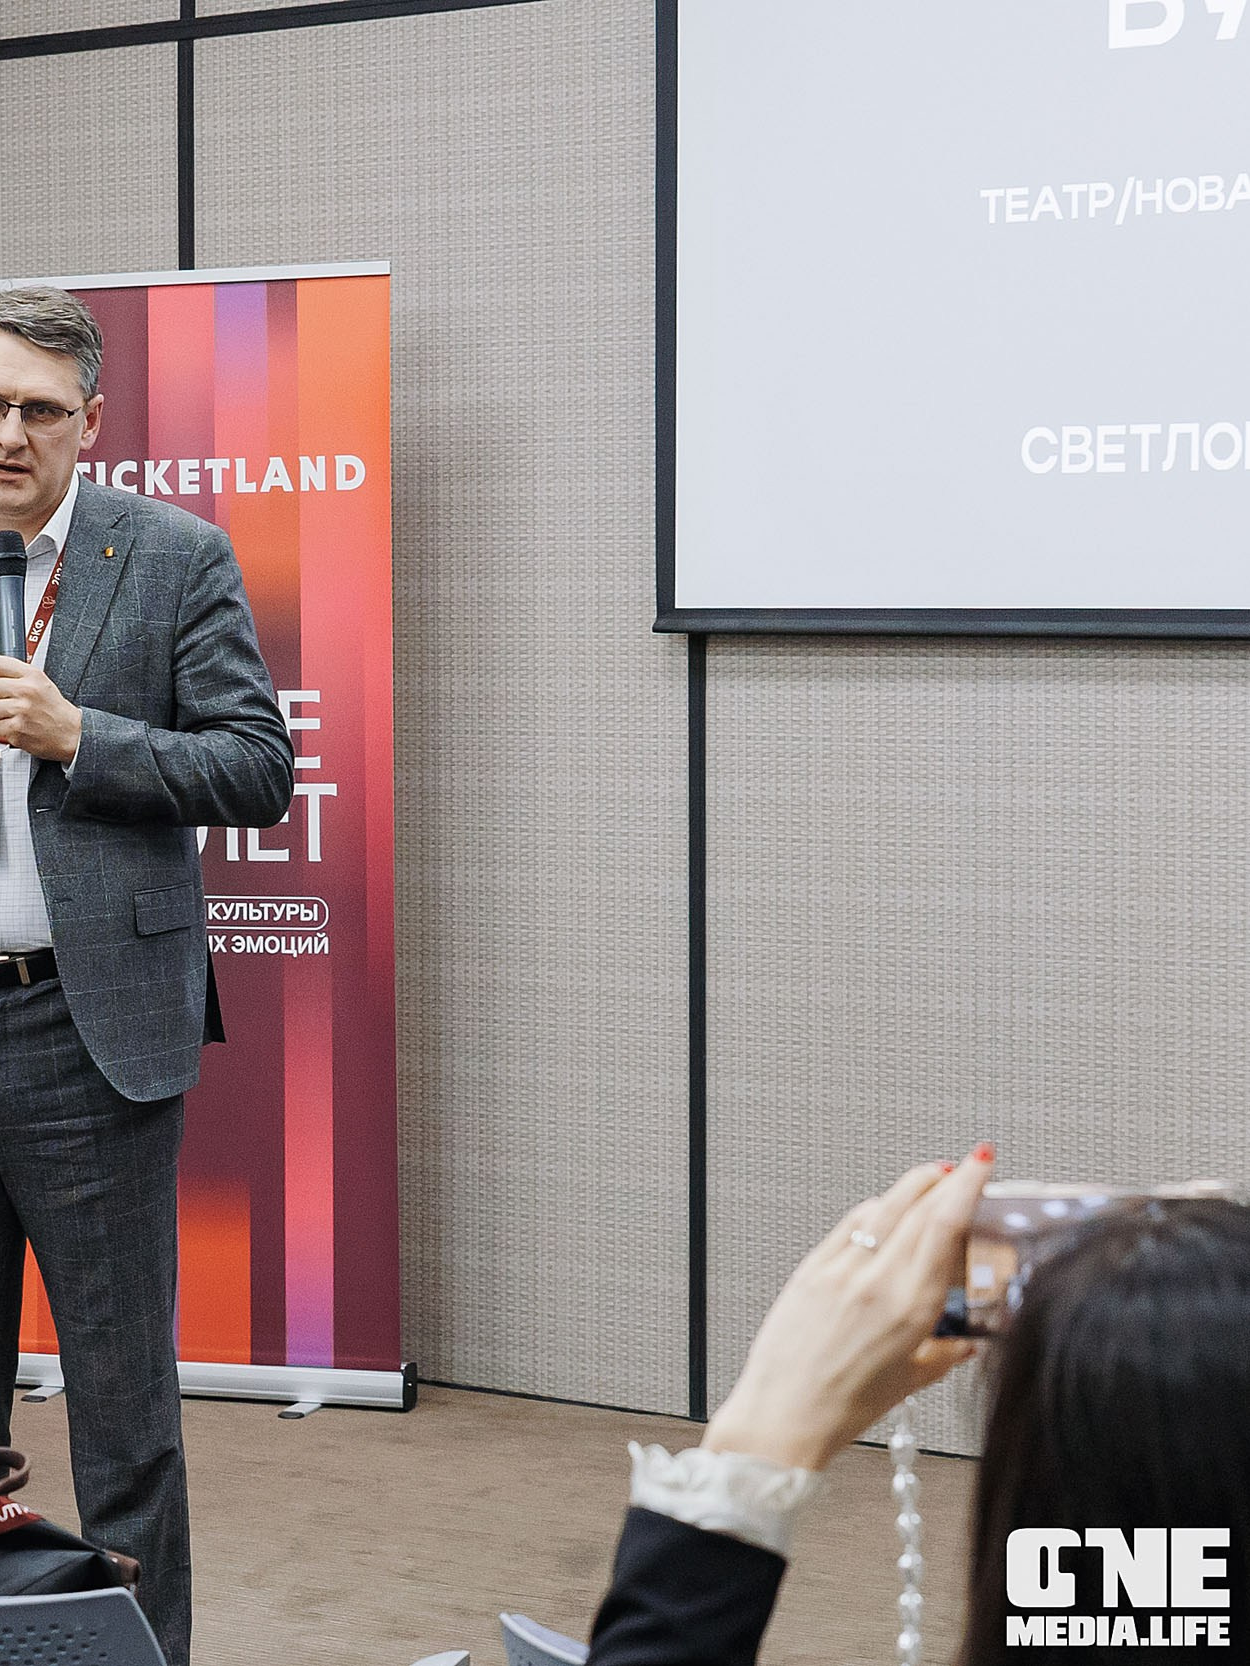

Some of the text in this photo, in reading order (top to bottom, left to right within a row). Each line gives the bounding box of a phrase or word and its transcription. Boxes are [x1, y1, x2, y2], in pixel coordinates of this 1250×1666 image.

[1021, 421, 1250, 474] СВЕТЛО
[29, 619, 44, 642] БКФ
[207, 903, 318, 921] КУЛЬТУРЫ
[231, 932, 329, 957] ЭМОЦИЙ
